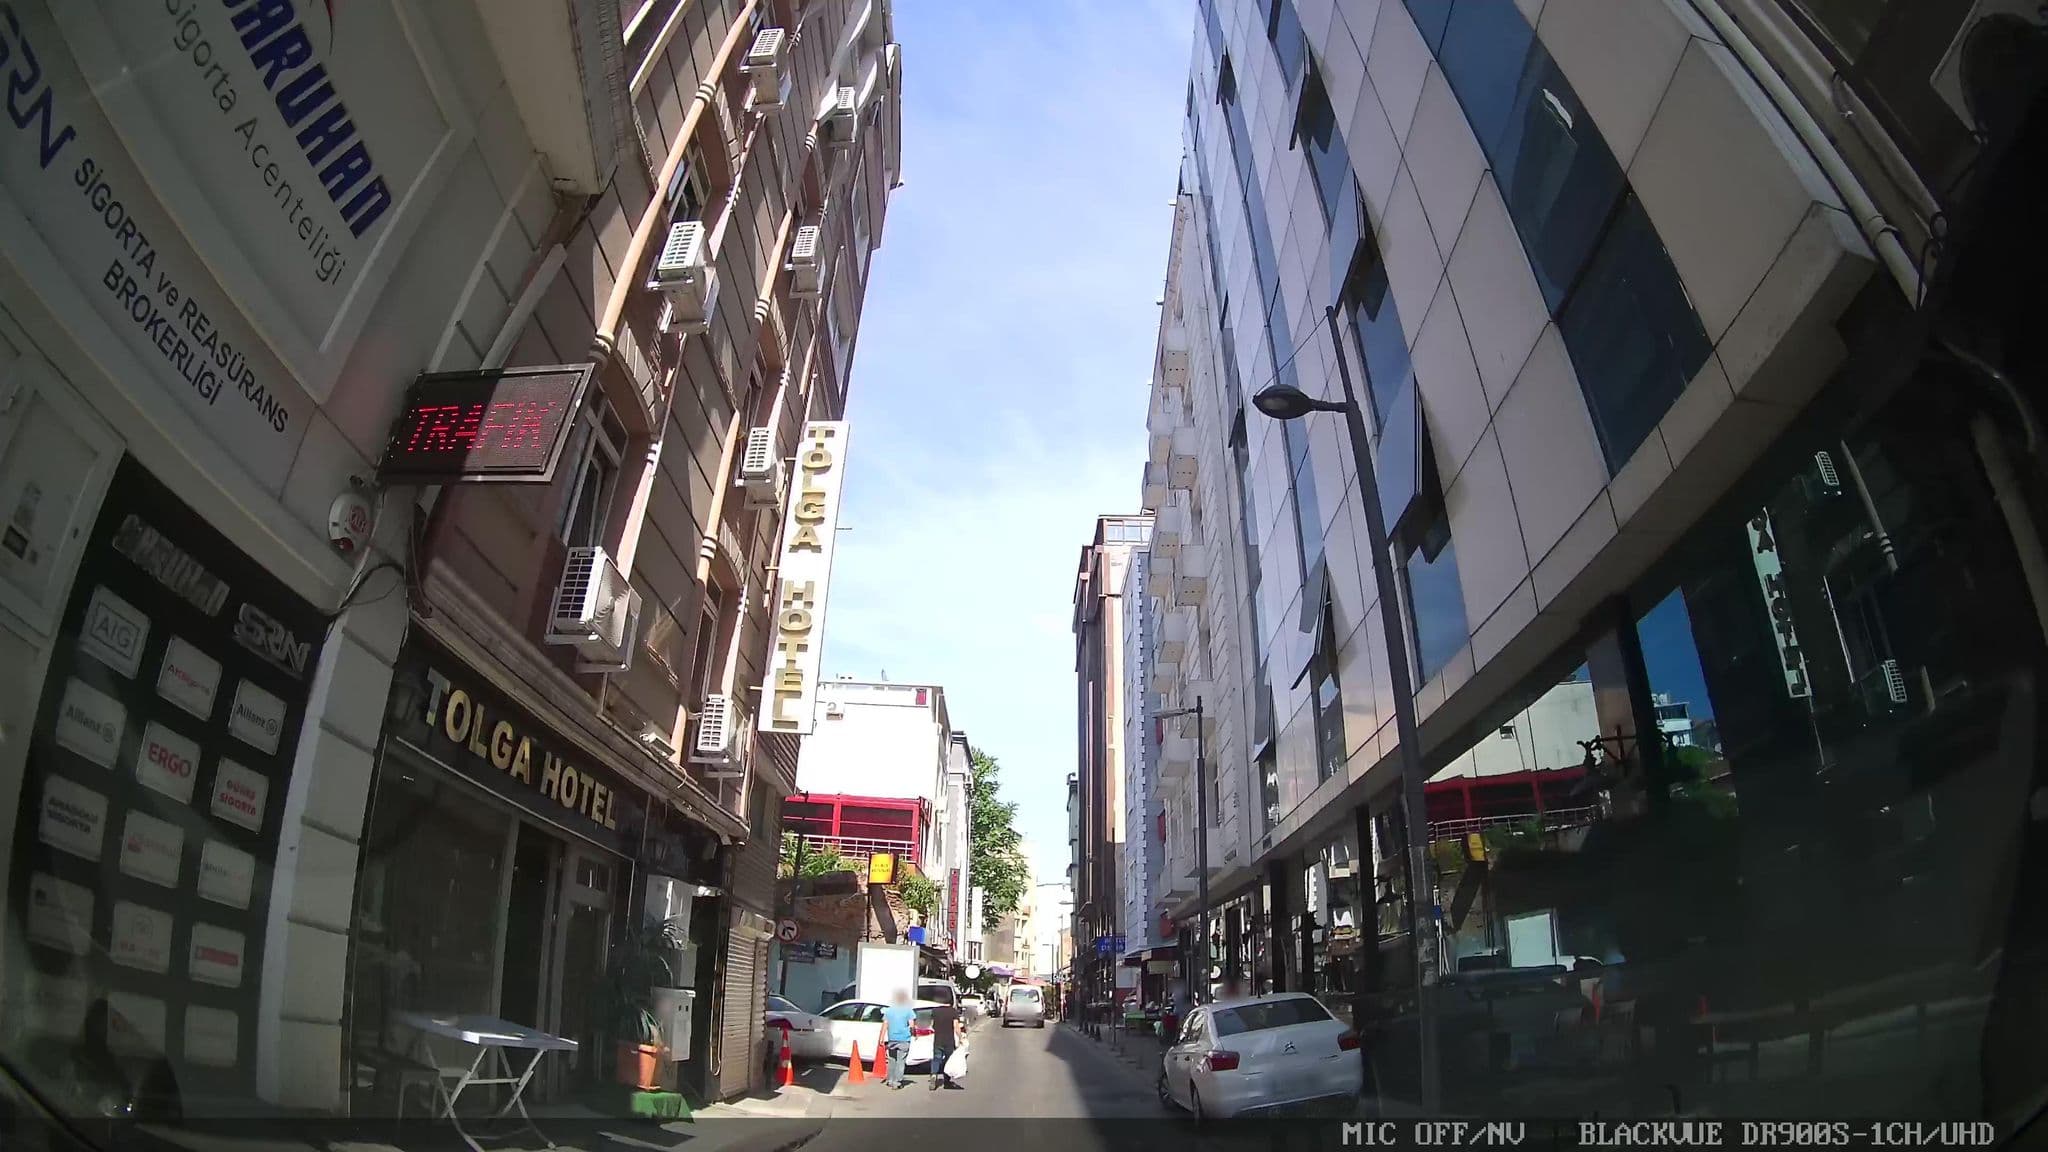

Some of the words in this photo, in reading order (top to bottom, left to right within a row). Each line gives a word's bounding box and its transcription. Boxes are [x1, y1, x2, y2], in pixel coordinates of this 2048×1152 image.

[221, 0, 392, 240] ARUHAN
[234, 117, 347, 286] Acenteliği
[74, 157, 156, 279] SİGORTA
[156, 270, 180, 306] ve
[178, 298, 289, 433] REASÜRANS
[102, 258, 224, 406] BROKERLİĞİ
[788, 425, 835, 554] TOLGA
[95, 615, 132, 648] AIG
[771, 580, 815, 729] HOTEL
[149, 742, 192, 779] ERGO
[425, 666, 531, 785] TOLGA
[539, 751, 616, 831] HOTEL
